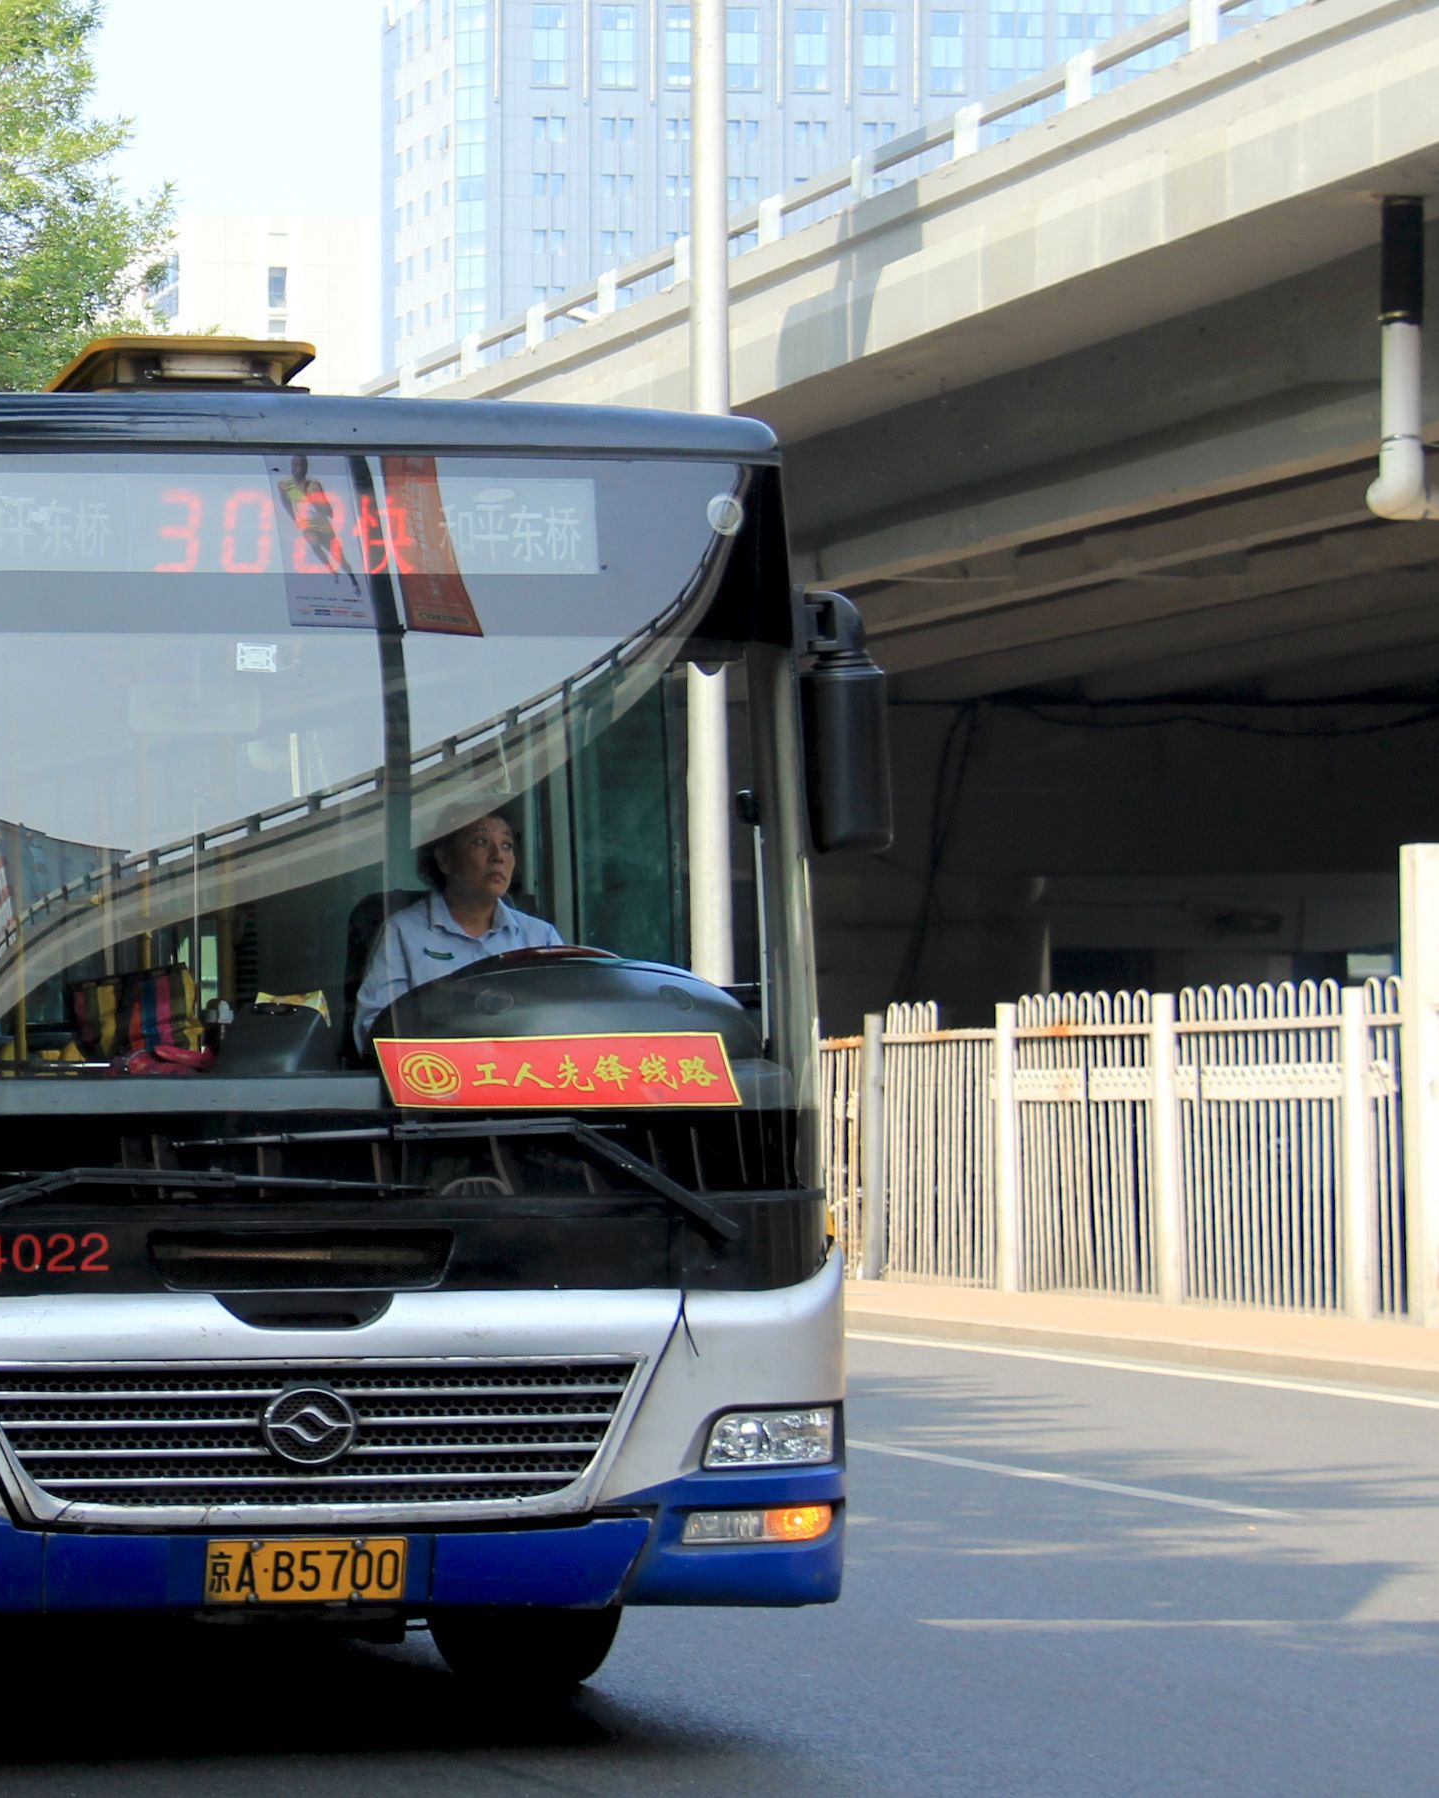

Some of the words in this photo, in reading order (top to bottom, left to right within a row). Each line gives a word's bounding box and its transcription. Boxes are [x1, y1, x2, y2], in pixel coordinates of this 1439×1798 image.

[438, 504, 582, 562] 和平东桥
[471, 1052, 720, 1093] 工人先锋线路
